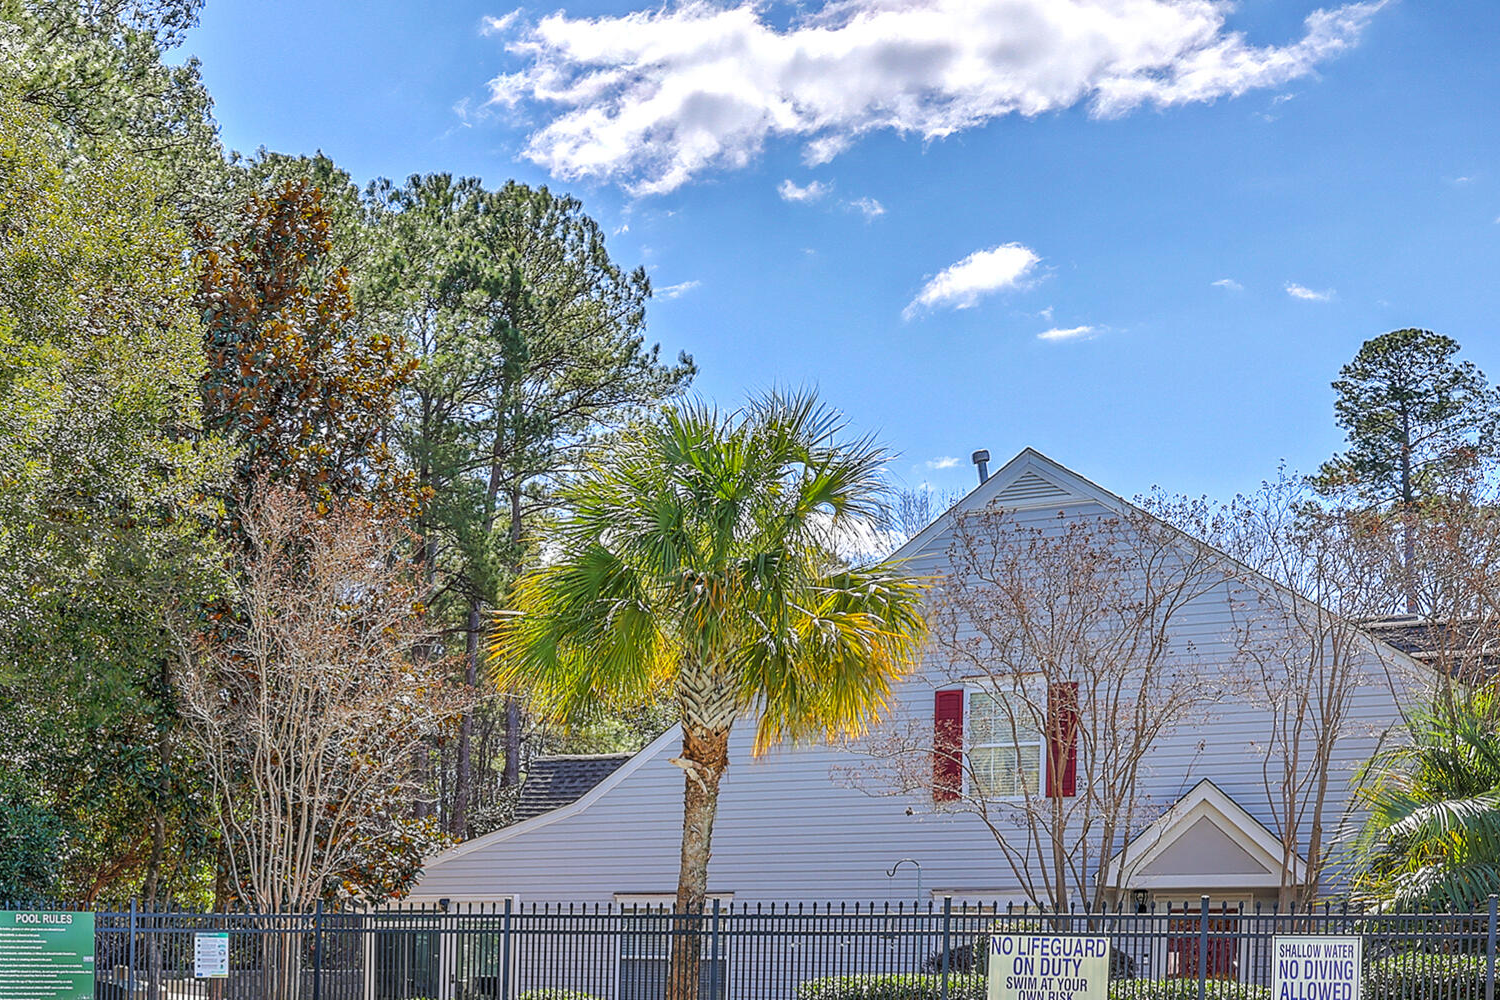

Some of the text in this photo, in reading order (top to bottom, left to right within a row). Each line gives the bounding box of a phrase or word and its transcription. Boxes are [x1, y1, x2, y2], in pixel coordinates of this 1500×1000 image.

[15, 913, 72, 924] POOL RULES
[991, 936, 1106, 958] NO LIFEGUARD
[1280, 944, 1354, 958] SHALLOW WATER
[1013, 957, 1082, 977] ON DUTY
[1279, 960, 1354, 980] NO DIVING
[1006, 976, 1087, 992] SWIM AT YOUR
